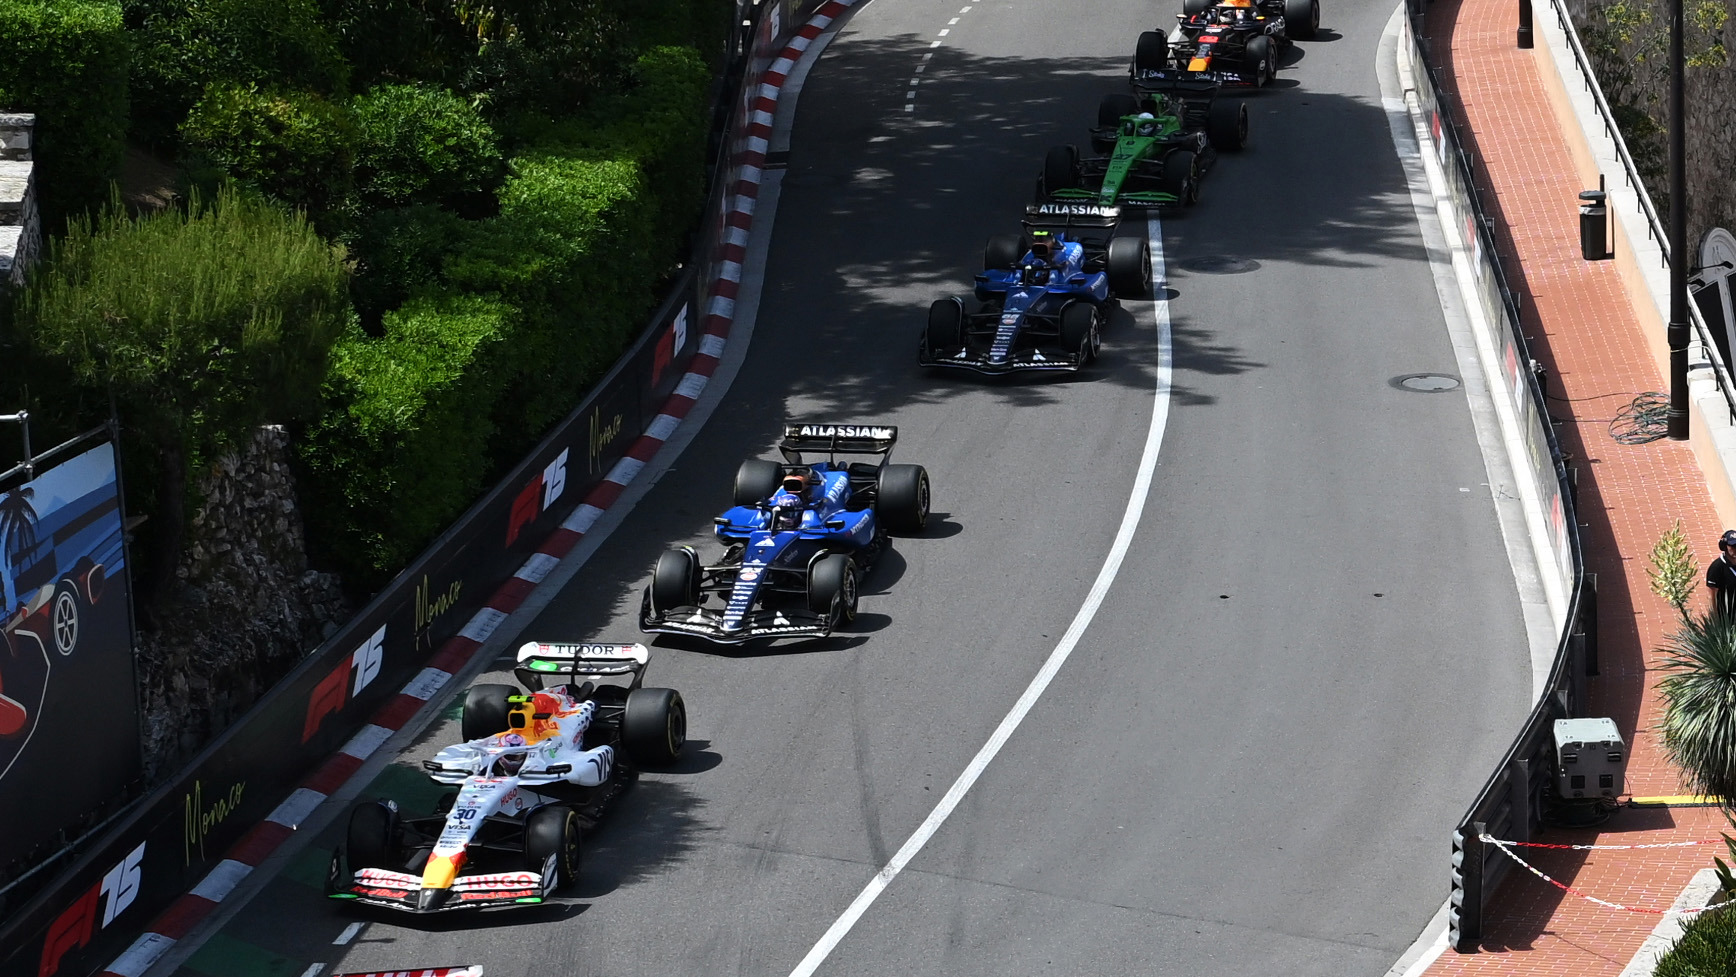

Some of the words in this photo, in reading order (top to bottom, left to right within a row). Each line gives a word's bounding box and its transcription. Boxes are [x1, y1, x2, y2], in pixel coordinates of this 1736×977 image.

[1039, 204, 1113, 216] ATLASSIAN
[801, 425, 884, 438] ATLASSIAN
[413, 574, 463, 650] Monaco
[349, 622, 387, 699] 75
[184, 779, 246, 867] Monaco
[453, 808, 477, 820] 30
[98, 840, 147, 930] 75
[467, 873, 533, 889] HUGO
